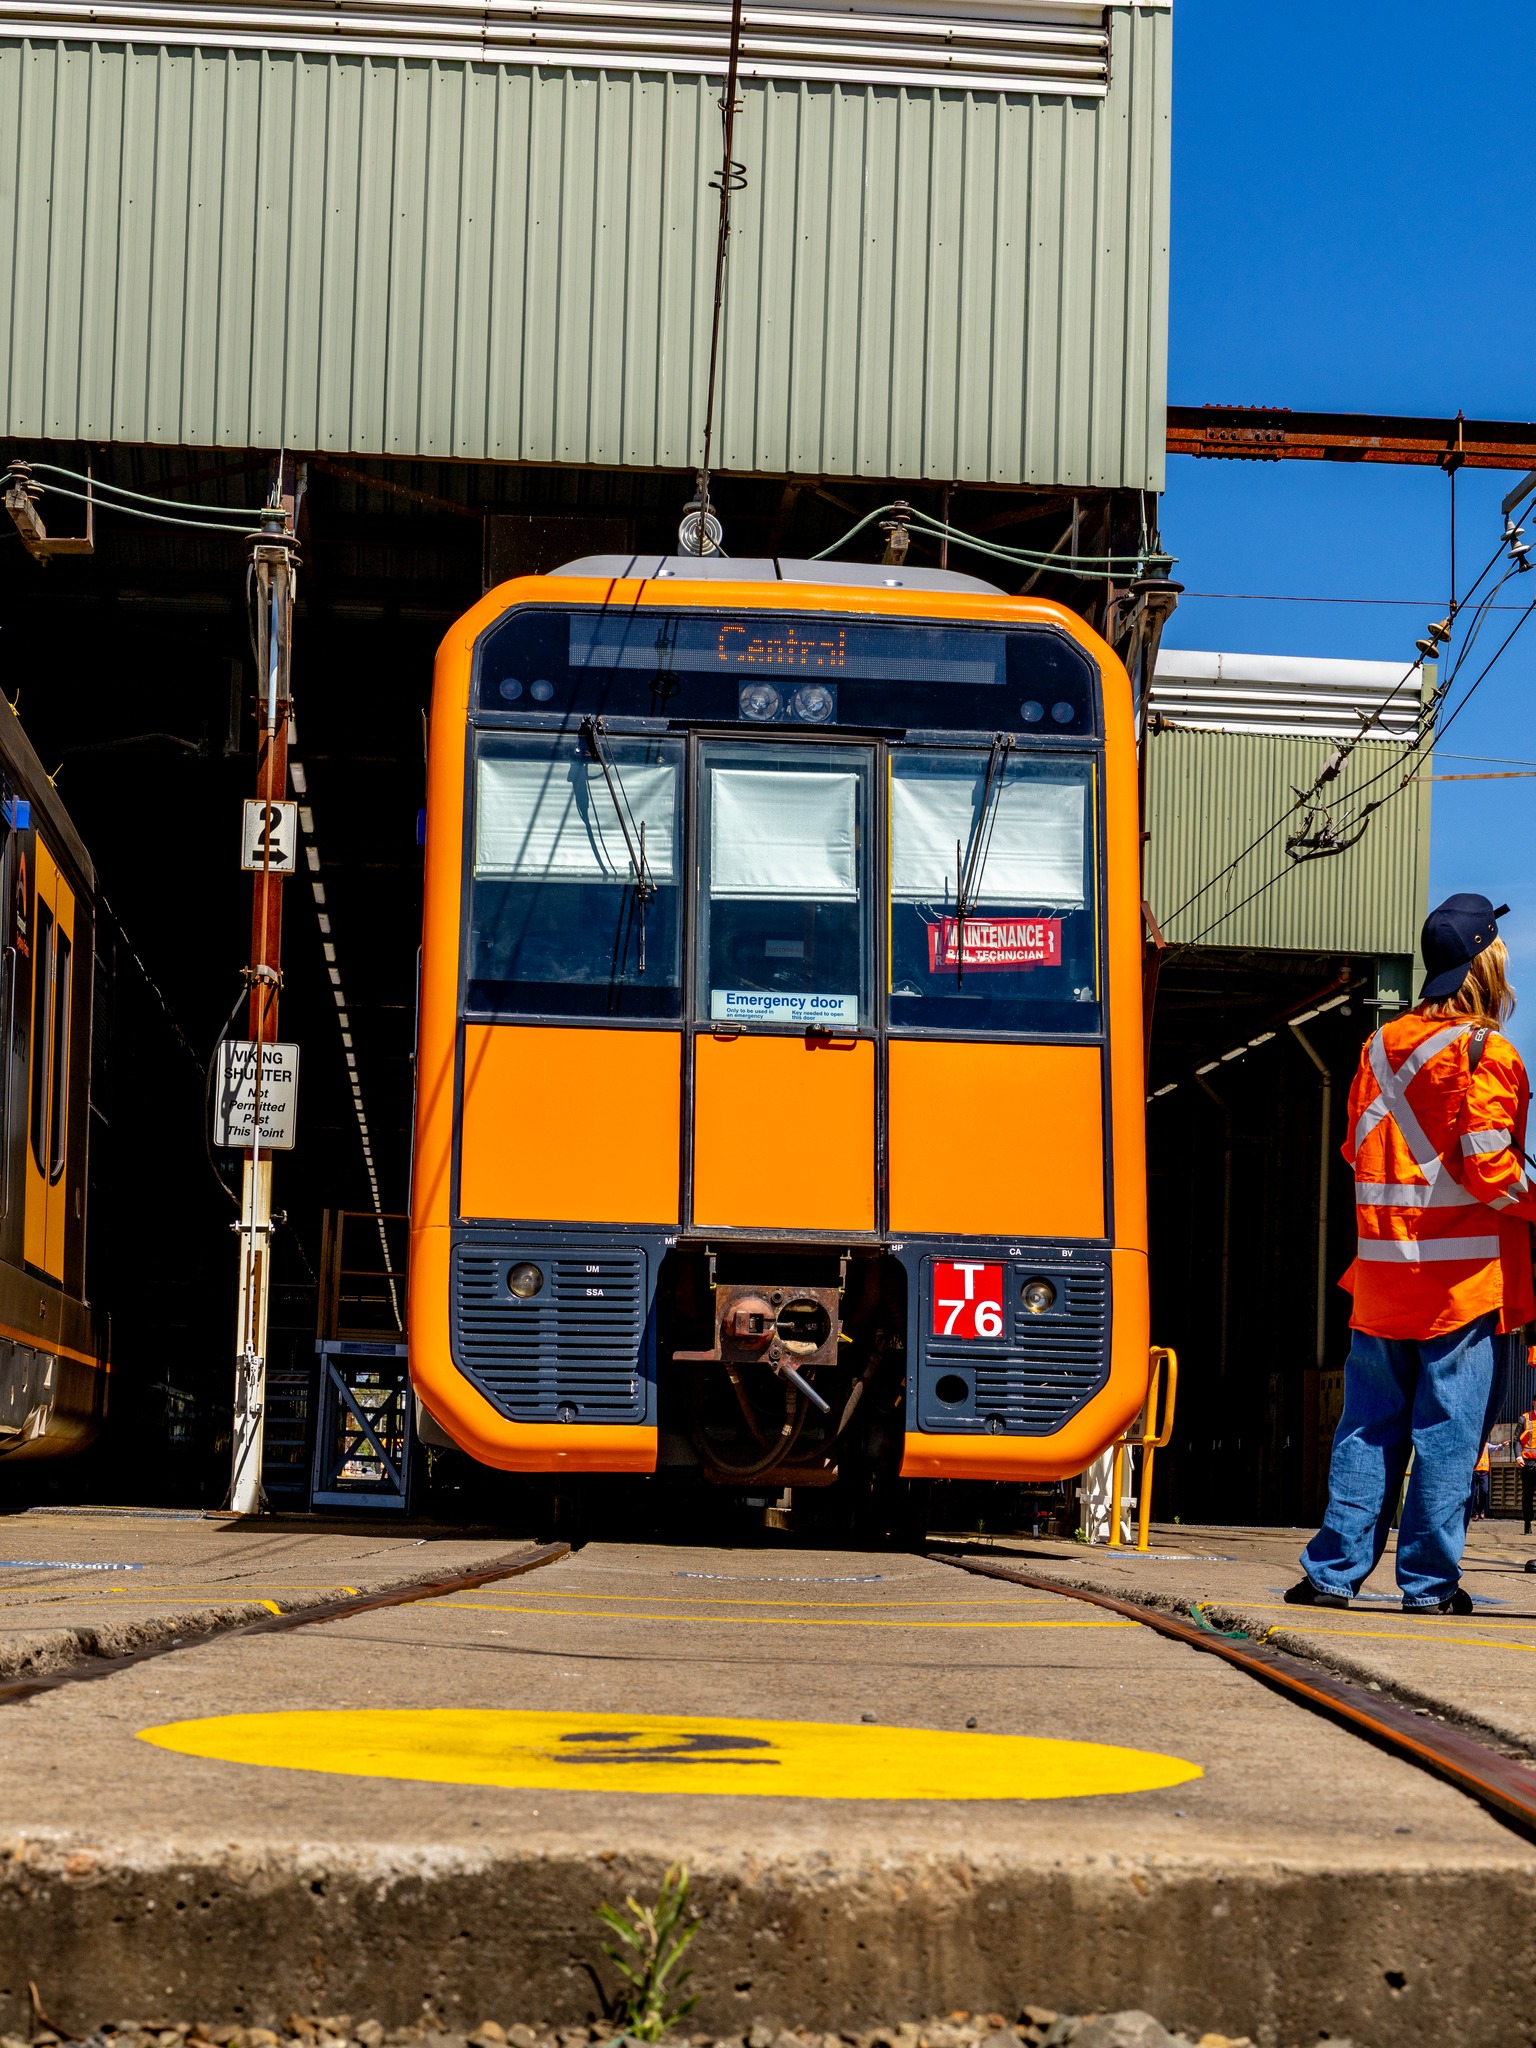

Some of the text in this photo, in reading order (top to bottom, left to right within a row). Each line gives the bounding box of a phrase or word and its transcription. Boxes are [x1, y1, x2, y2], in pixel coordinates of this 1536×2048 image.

[719, 626, 845, 666] Central
[258, 806, 282, 846] 2
[975, 950, 1044, 961] TECHNICIAN
[726, 993, 844, 1009] Emergency door
[235, 1050, 283, 1065] VIKNG
[228, 1126, 251, 1136] This
[1009, 1248, 1022, 1256] CA
[1061, 1249, 1074, 1257] BV
[586, 1265, 600, 1273] UM
[953, 1262, 985, 1300] T
[586, 1288, 604, 1297] SSA
[938, 1299, 1003, 1337] 76
[553, 1731, 782, 1765] 2
